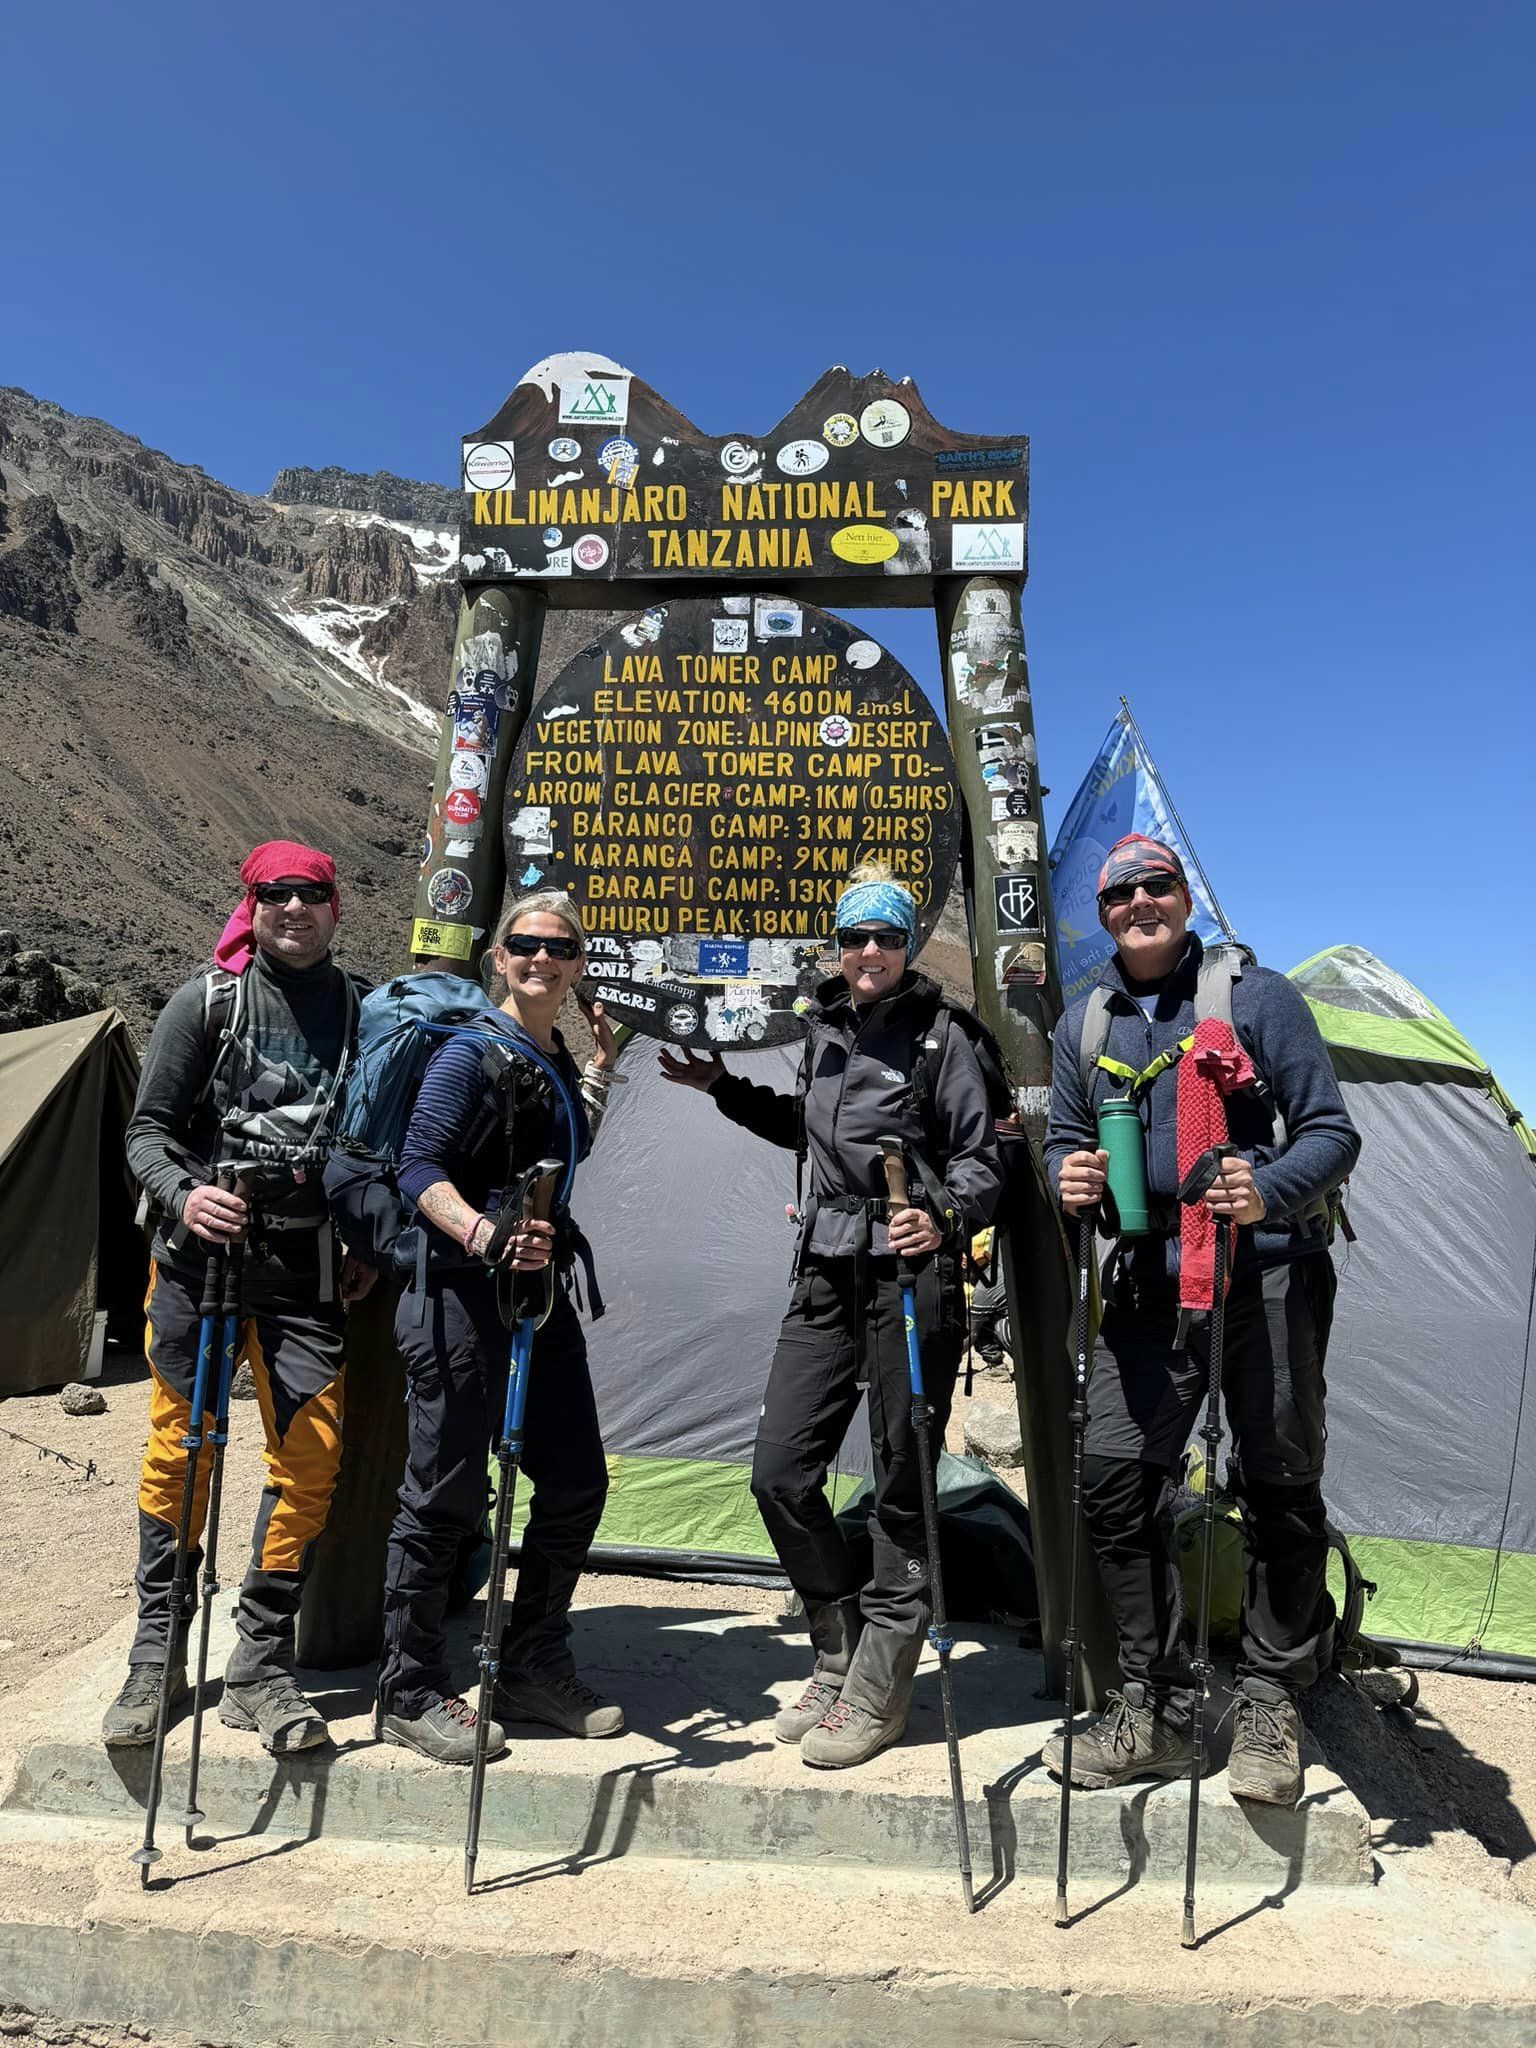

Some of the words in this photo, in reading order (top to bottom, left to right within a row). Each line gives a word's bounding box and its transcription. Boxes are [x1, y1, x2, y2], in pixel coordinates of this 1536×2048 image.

[474, 484, 687, 526] KILIMANJARO
[722, 481, 886, 521] NATIONAL
[932, 480, 1015, 518] PARK
[648, 528, 812, 568] TANZANIA
[604, 656, 663, 684] LAVA
[677, 655, 759, 684] TOWER
[772, 655, 837, 684] CAMP
[594, 690, 752, 715] ELEVATION:
[764, 690, 851, 716] 4600M
[857, 691, 915, 717] amsl
[537, 720, 661, 745] VEGETATION
[677, 720, 743, 746] ZONE:
[749, 720, 821, 747] ALPINE
[849, 721, 932, 748] DESERT
[526, 751, 603, 775] FROM
[616, 751, 681, 775] LAVA
[702, 752, 793, 777] TOWER
[808, 753, 882, 778] CAMP
[526, 782, 601, 805] ARROW
[614, 782, 720, 806] GLACIER
[736, 784, 811, 808] CAMP:
[816, 785, 858, 809] 1KM
[863, 781, 954, 815] (0.5HRS)
[573, 811, 693, 838] BARANCO
[710, 814, 789, 839] CAMP:
[862, 813, 932, 845] 2HRS)
[574, 843, 693, 869] KARANGA
[709, 845, 783, 869] CAMP:
[793, 847, 848, 872] 9KM
[588, 876, 694, 900] BARAFU
[707, 877, 780, 902] CAMP:
[582, 905, 669, 933] UHURU
